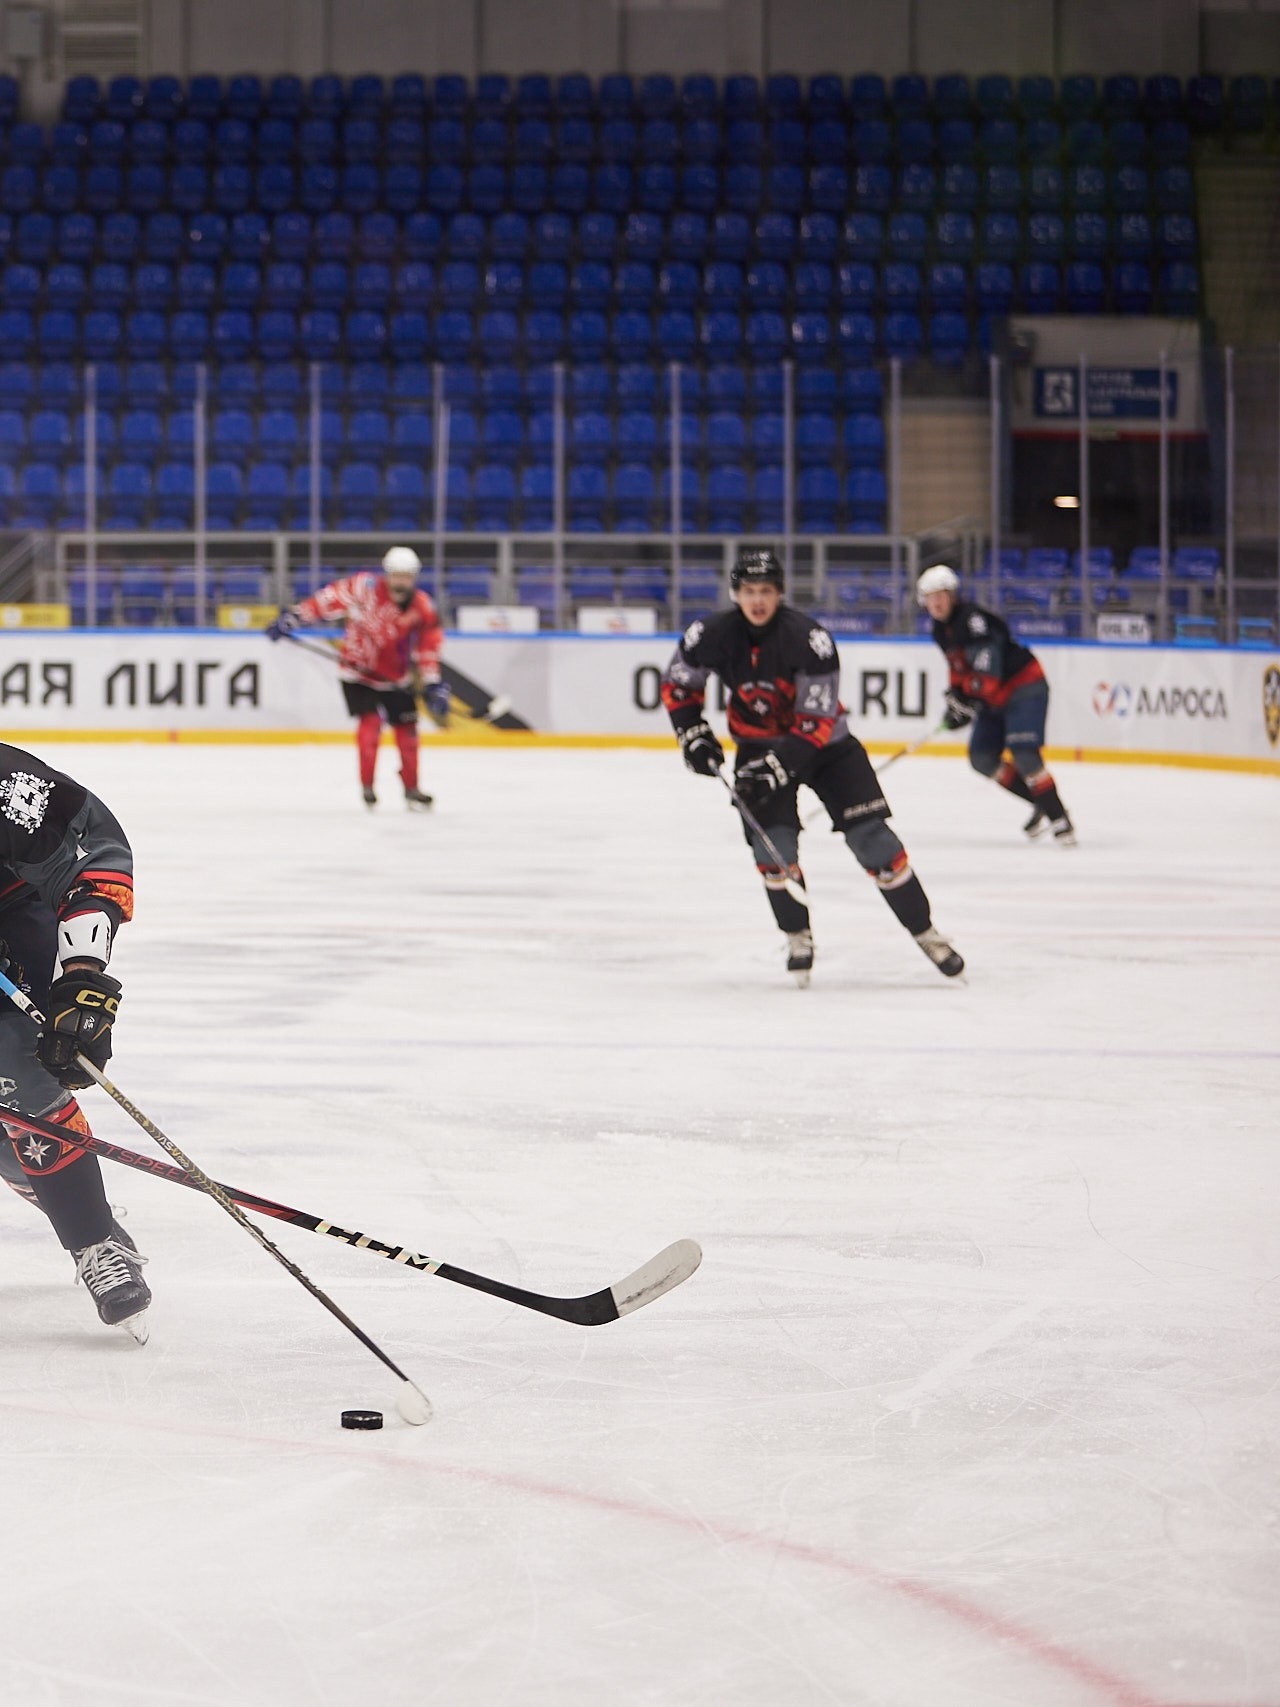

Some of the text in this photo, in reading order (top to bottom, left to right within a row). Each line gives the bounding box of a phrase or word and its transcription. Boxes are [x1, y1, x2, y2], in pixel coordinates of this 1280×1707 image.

[105, 661, 260, 706] ЛИГА
[803, 683, 832, 713] 24
[111, 1086, 148, 1124] TACKS
[314, 1219, 445, 1275] CCM
